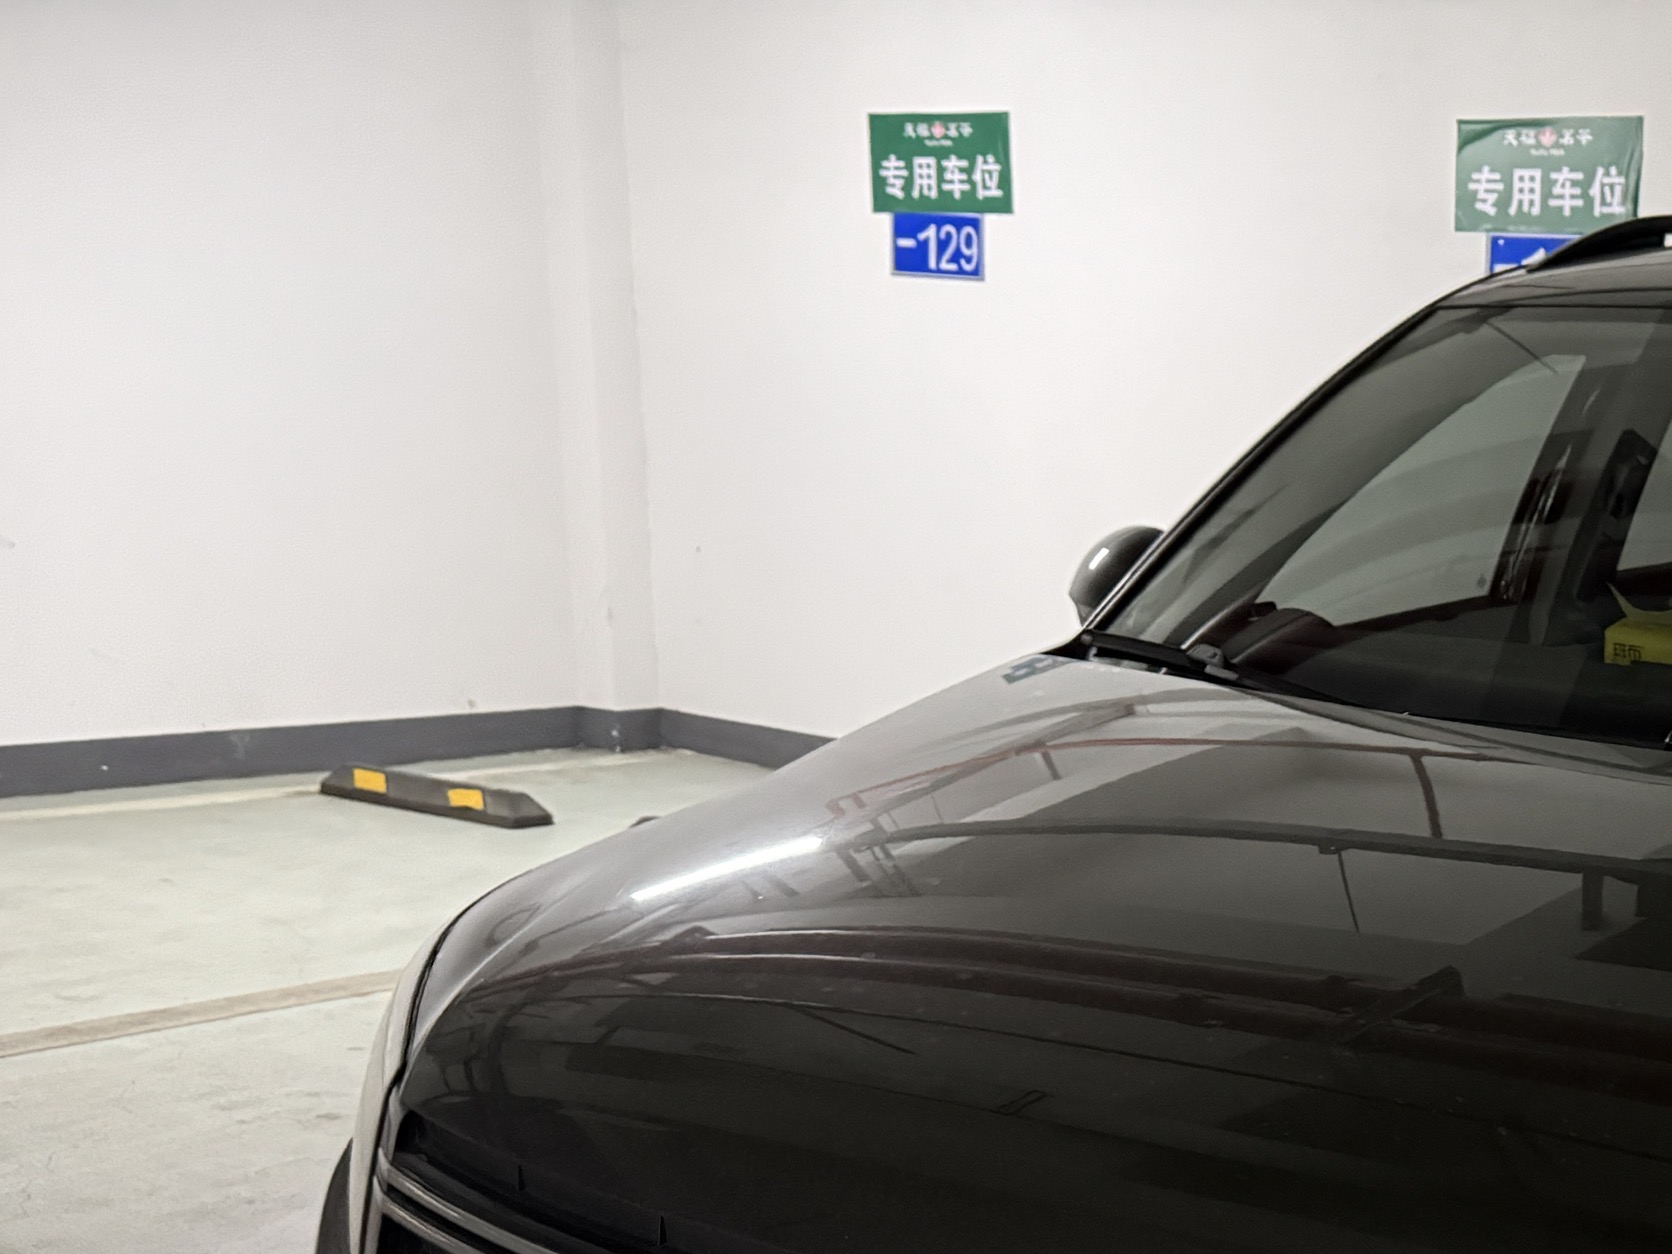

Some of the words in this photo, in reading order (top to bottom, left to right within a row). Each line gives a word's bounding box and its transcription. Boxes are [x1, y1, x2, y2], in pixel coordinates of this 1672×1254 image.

[879, 155, 1003, 200] 专用车位
[1468, 165, 1627, 217] 专用车位
[896, 223, 978, 272] -129
